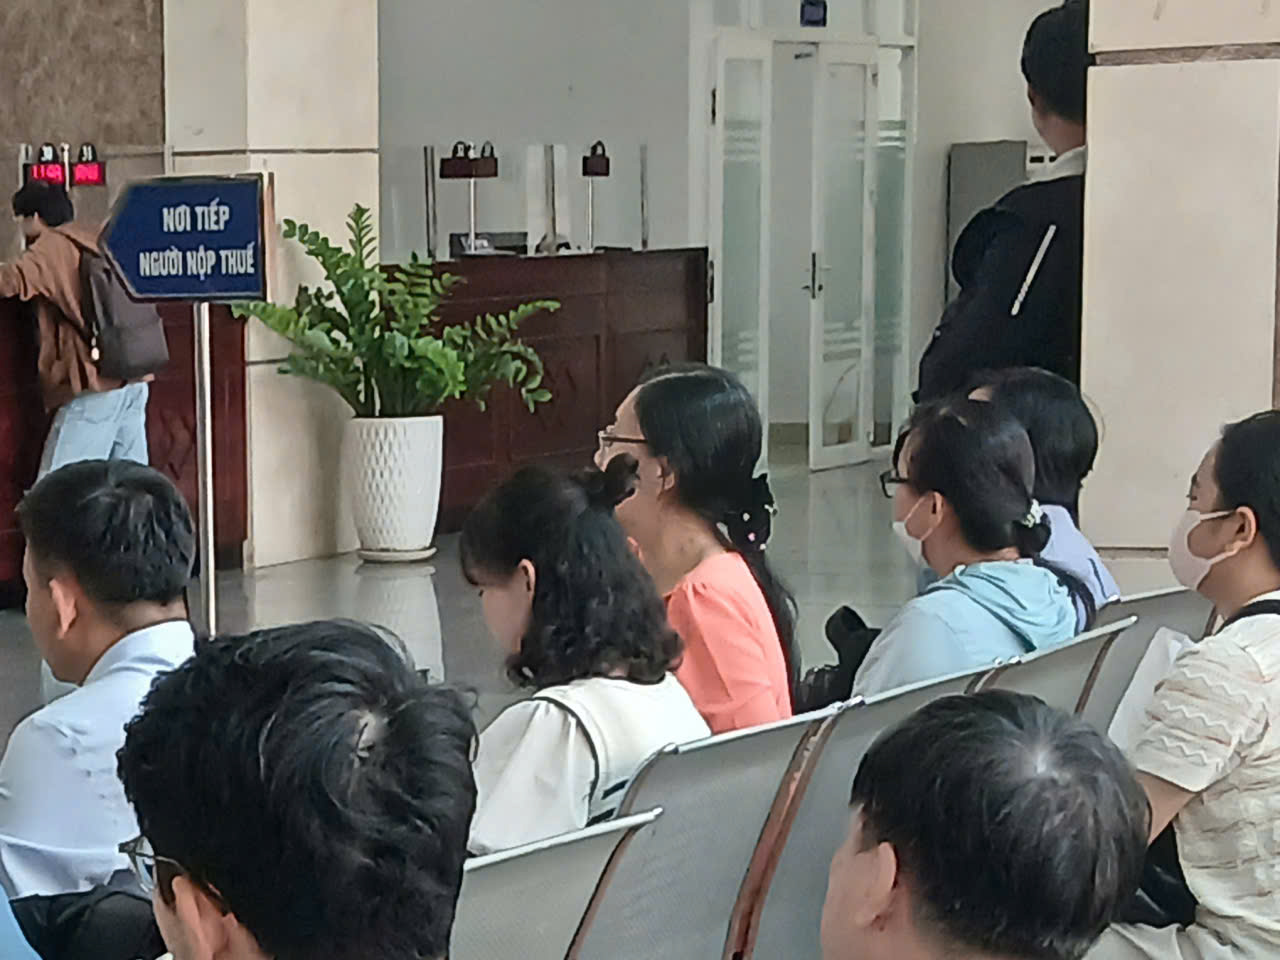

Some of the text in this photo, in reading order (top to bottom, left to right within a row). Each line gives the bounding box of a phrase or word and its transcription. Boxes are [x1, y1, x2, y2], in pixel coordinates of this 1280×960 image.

[162, 197, 230, 232] NƠI TIẾP
[139, 241, 255, 281] NGƯỜI NỘP THUẾ
